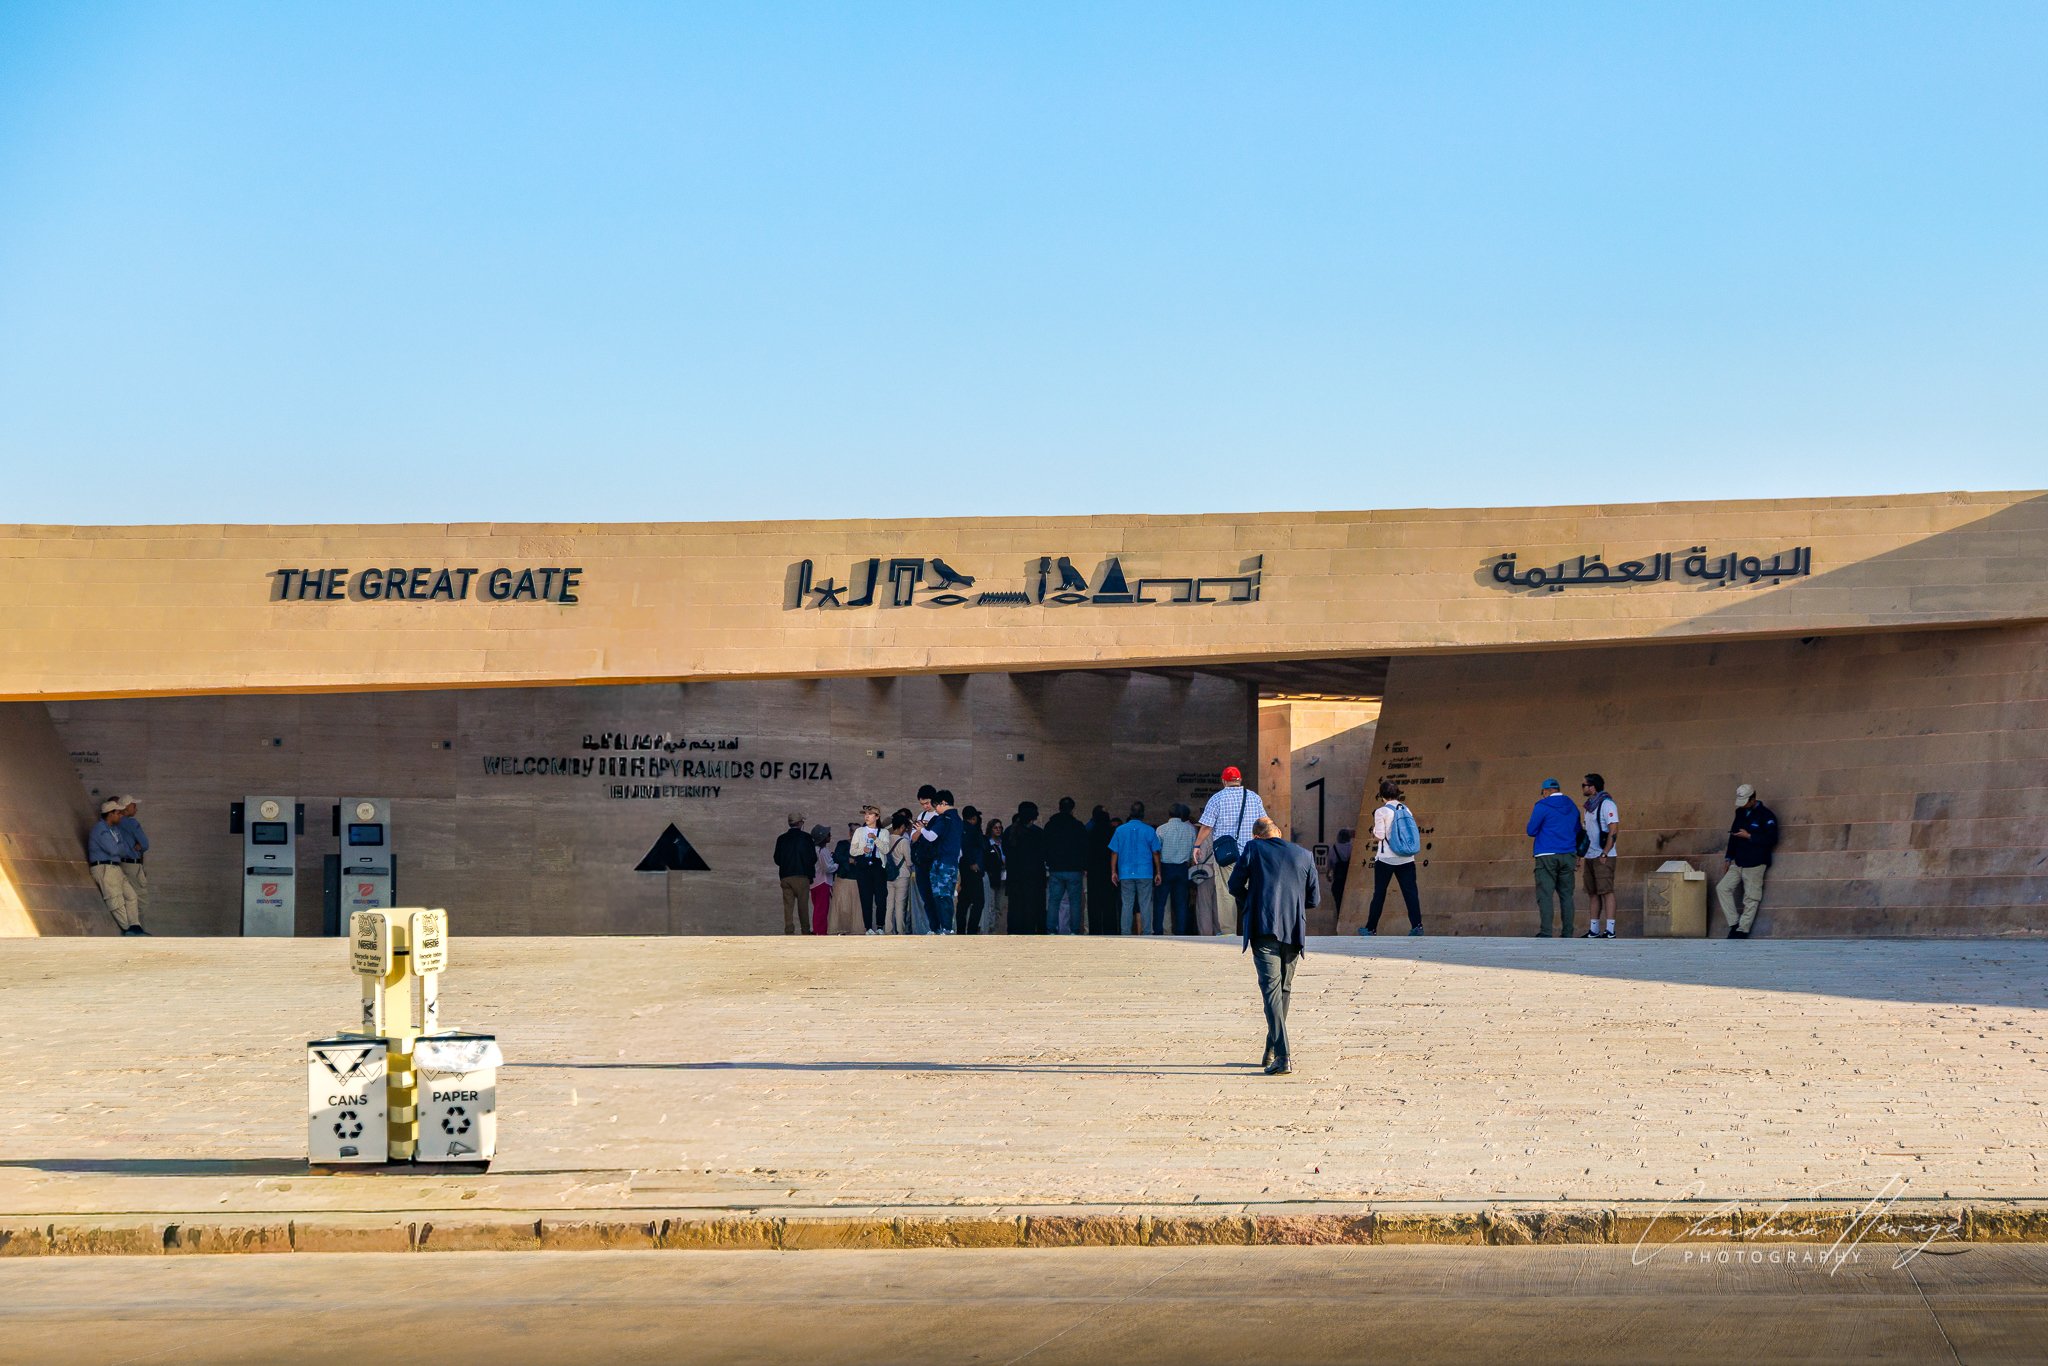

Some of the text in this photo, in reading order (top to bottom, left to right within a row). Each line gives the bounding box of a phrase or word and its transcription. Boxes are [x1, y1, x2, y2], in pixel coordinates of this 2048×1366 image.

[1493, 546, 1811, 592] البوابة العظيمة
[277, 567, 583, 605] THE GREAT GATE
[760, 761, 784, 779] OF
[789, 762, 833, 780] GIZA
[662, 785, 721, 799] ETERNITY
[1306, 777, 1325, 843] 1
[328, 1094, 368, 1106] CANS
[432, 1090, 479, 1103] PAPER
